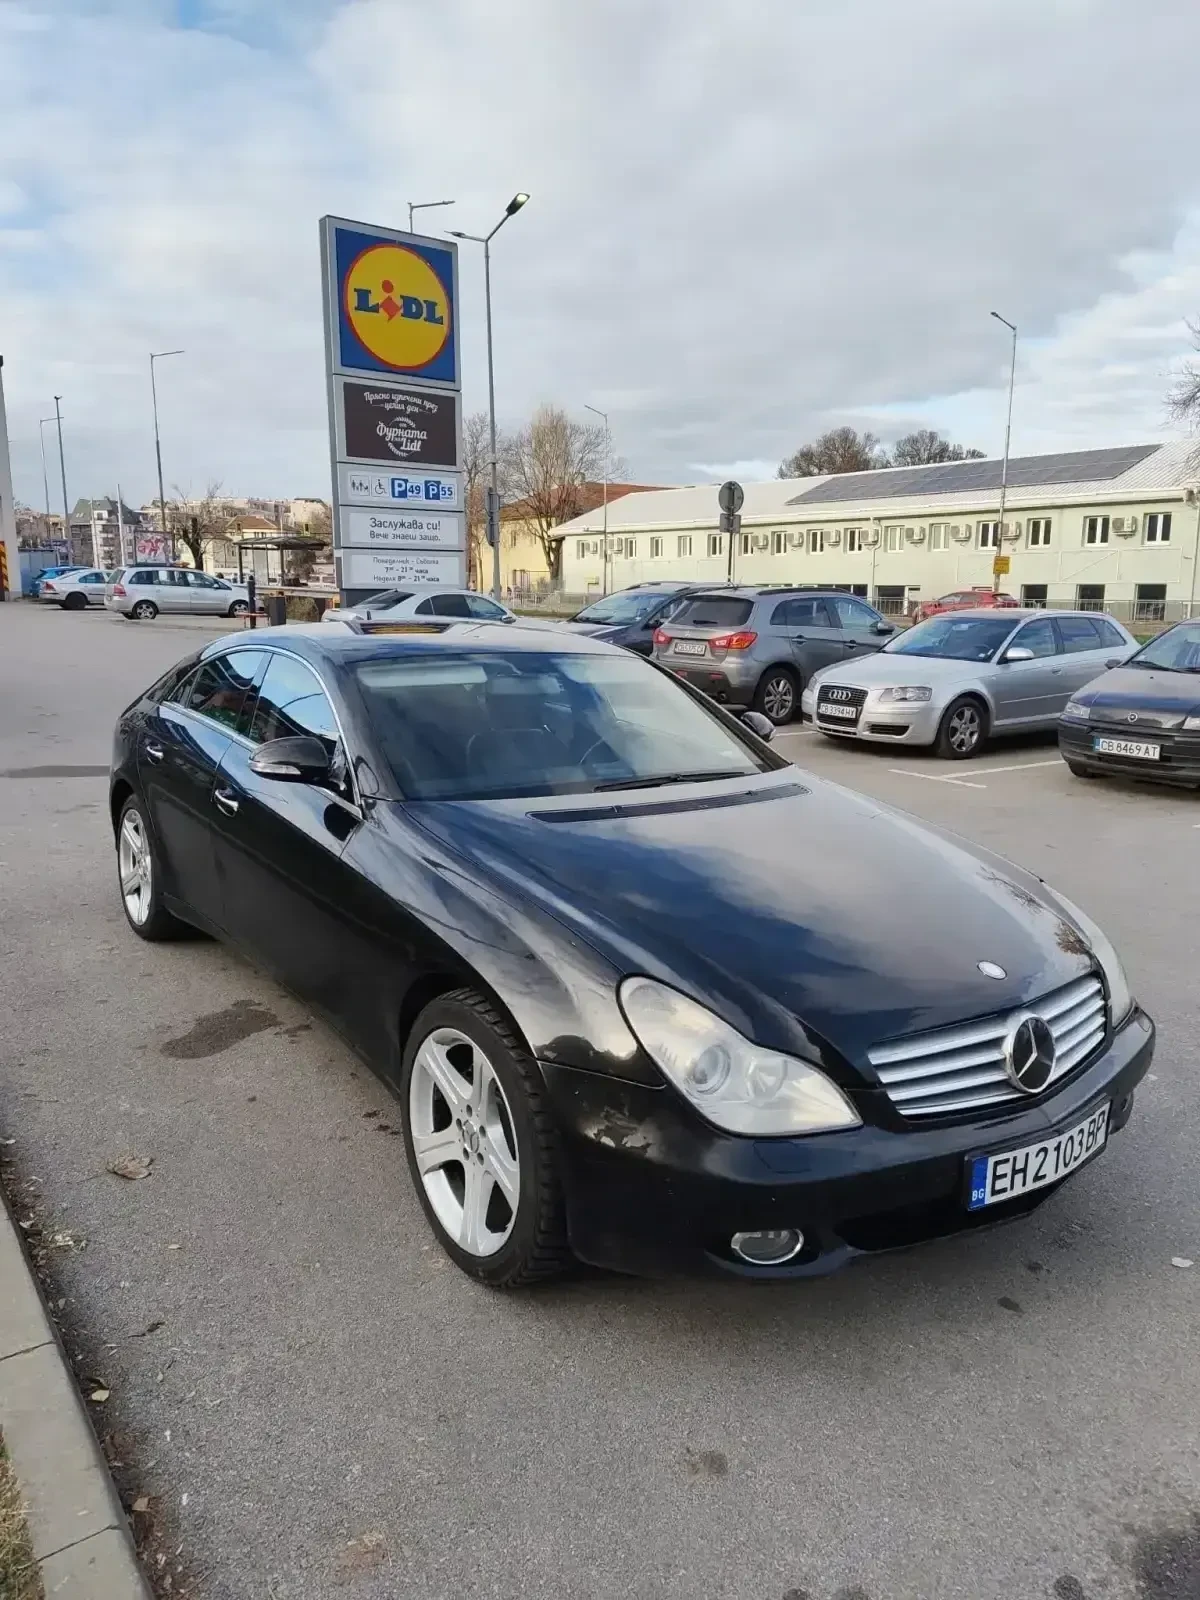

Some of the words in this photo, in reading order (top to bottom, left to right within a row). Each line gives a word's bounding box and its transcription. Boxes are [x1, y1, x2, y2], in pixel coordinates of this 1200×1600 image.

[376, 421, 428, 441] Фурната
[400, 437, 422, 451] Lidl
[407, 484, 421, 495] 49
[441, 486, 453, 496] 55
[369, 517, 424, 531] Заслужава
[426, 520, 441, 531] си!
[369, 530, 389, 539] Вече
[1101, 740, 1114, 752] CB
[1116, 742, 1141, 755] 8469
[1143, 746, 1159, 757] AT
[971, 1188, 985, 1201] BG
